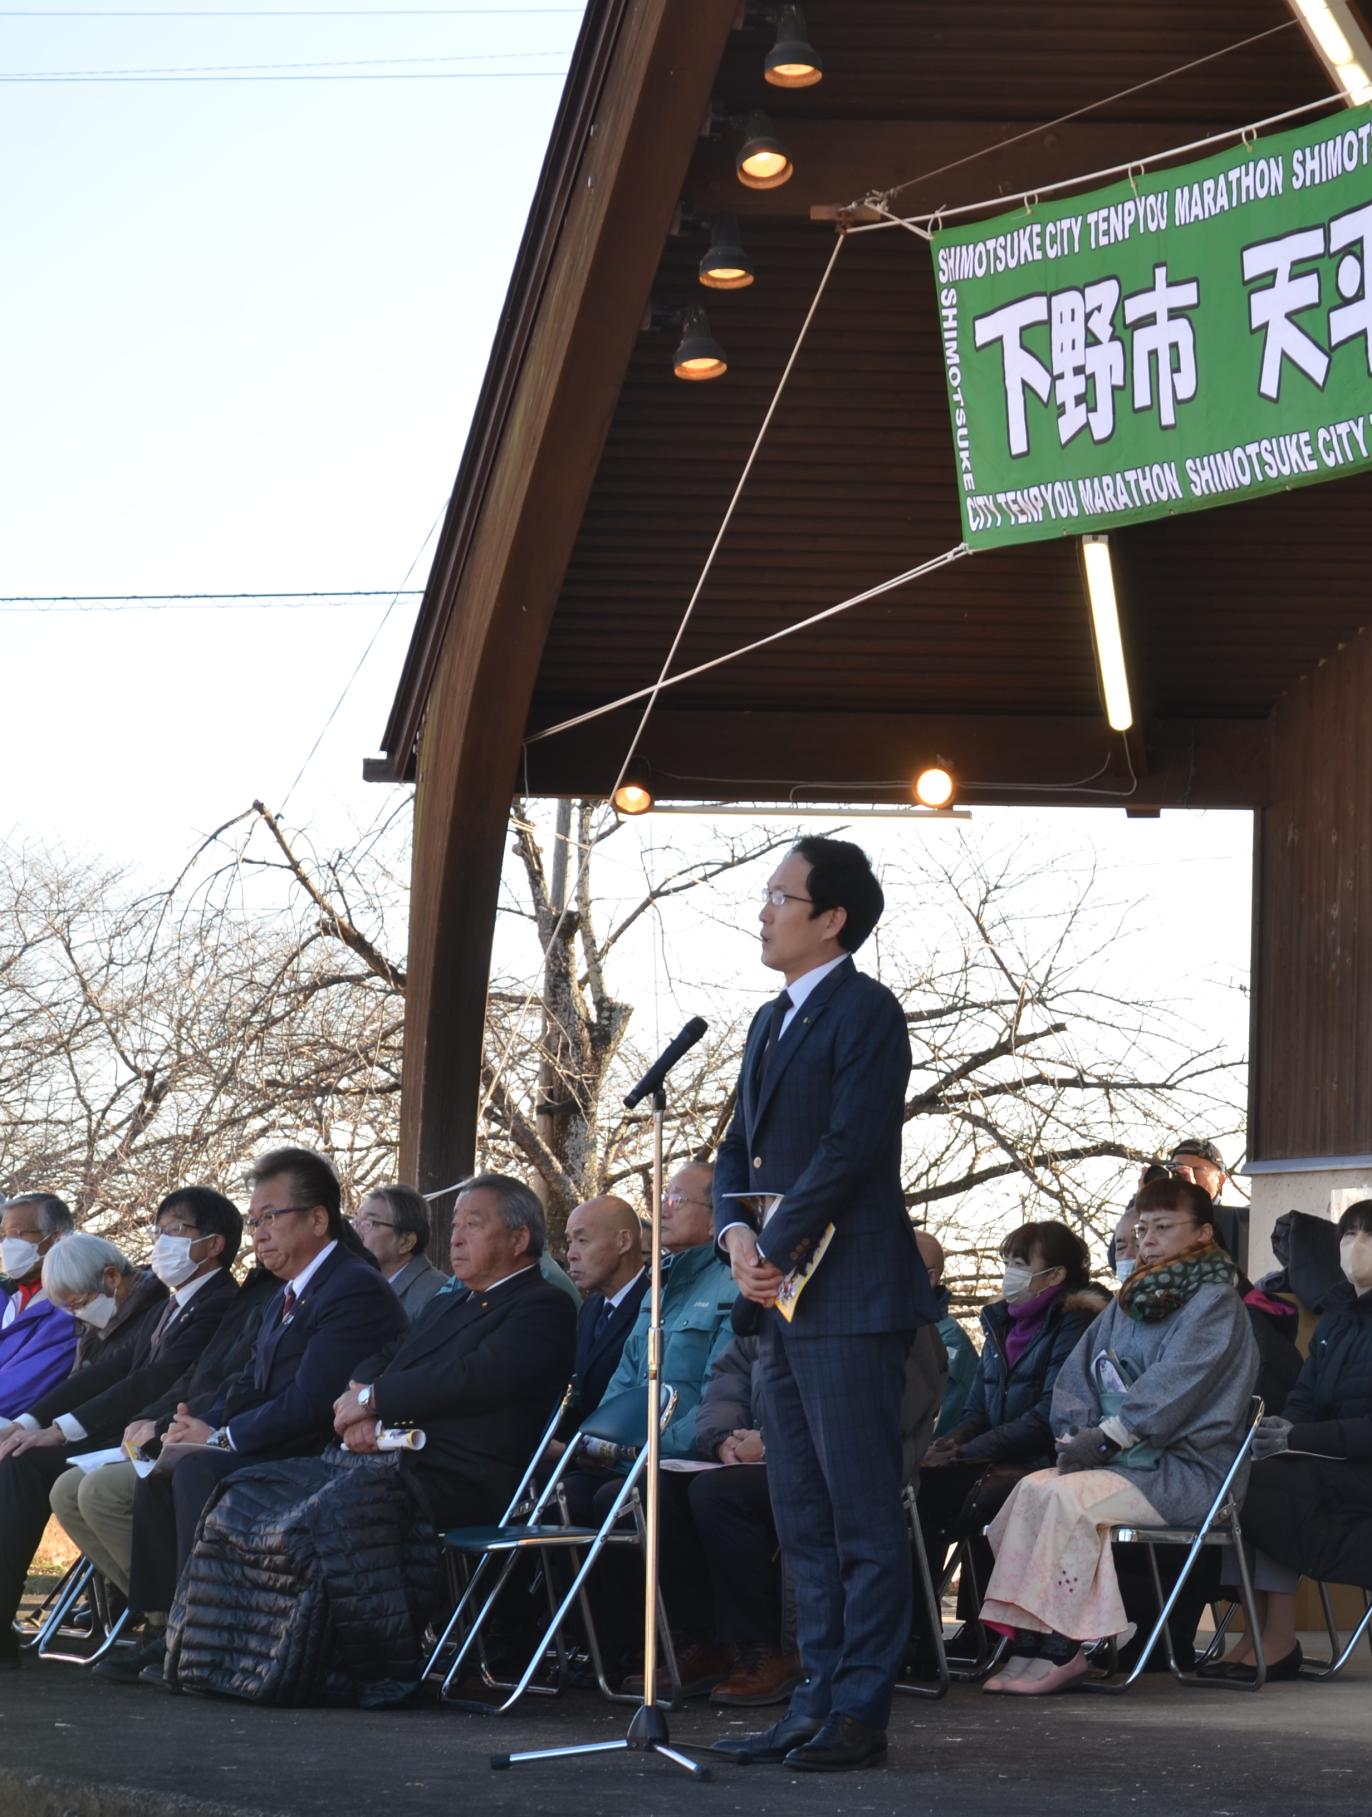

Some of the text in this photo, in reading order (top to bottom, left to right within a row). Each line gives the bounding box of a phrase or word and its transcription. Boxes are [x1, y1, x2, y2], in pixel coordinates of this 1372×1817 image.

[937, 223, 1043, 285] SHIMOTSUKE
[1044, 217, 1083, 260] CITY
[1086, 191, 1169, 250] TENPYOU
[1174, 157, 1284, 227] MARATHON
[940, 286, 976, 492] SHIMOTSUKE
[974, 265, 1199, 456] 下野市
[966, 493, 1003, 534] CITY
[1001, 481, 1080, 528] TENPYOU
[1077, 460, 1184, 517] MARATHON
[1184, 431, 1319, 498] SHIMOTSUKE
[1316, 414, 1371, 469] CITY
